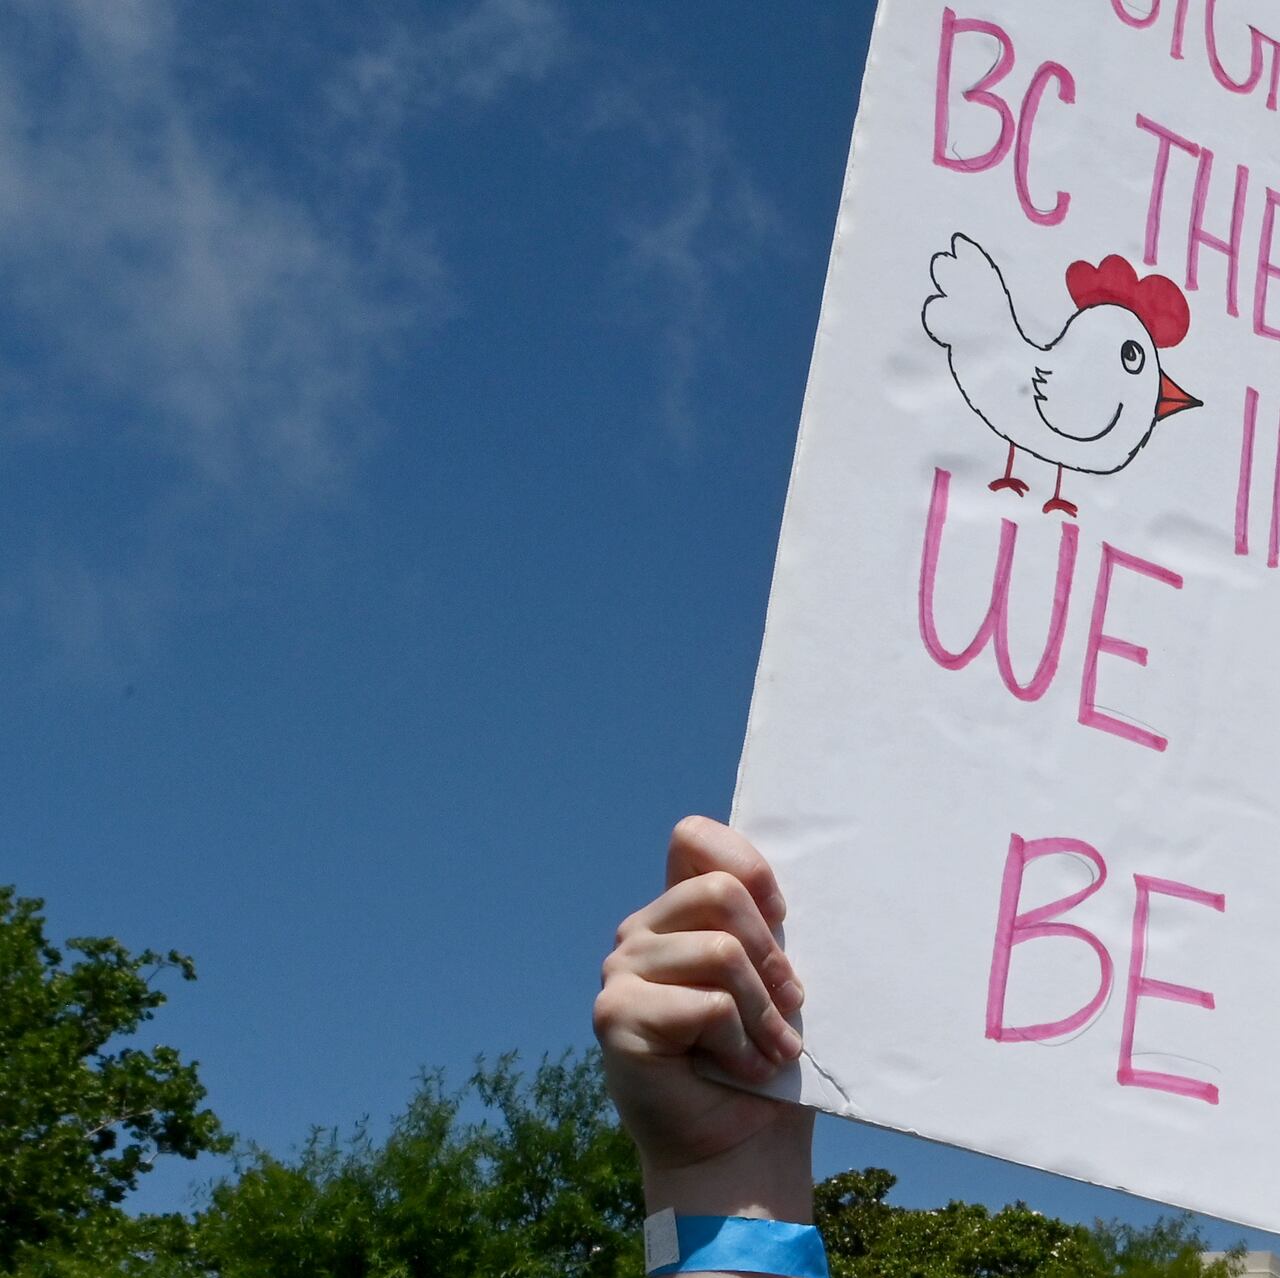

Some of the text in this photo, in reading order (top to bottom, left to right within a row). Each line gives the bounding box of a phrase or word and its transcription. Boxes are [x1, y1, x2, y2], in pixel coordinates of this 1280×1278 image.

[930, 9, 1074, 226] BC
[918, 468, 1182, 753] WE
[984, 832, 1226, 1105] BE
